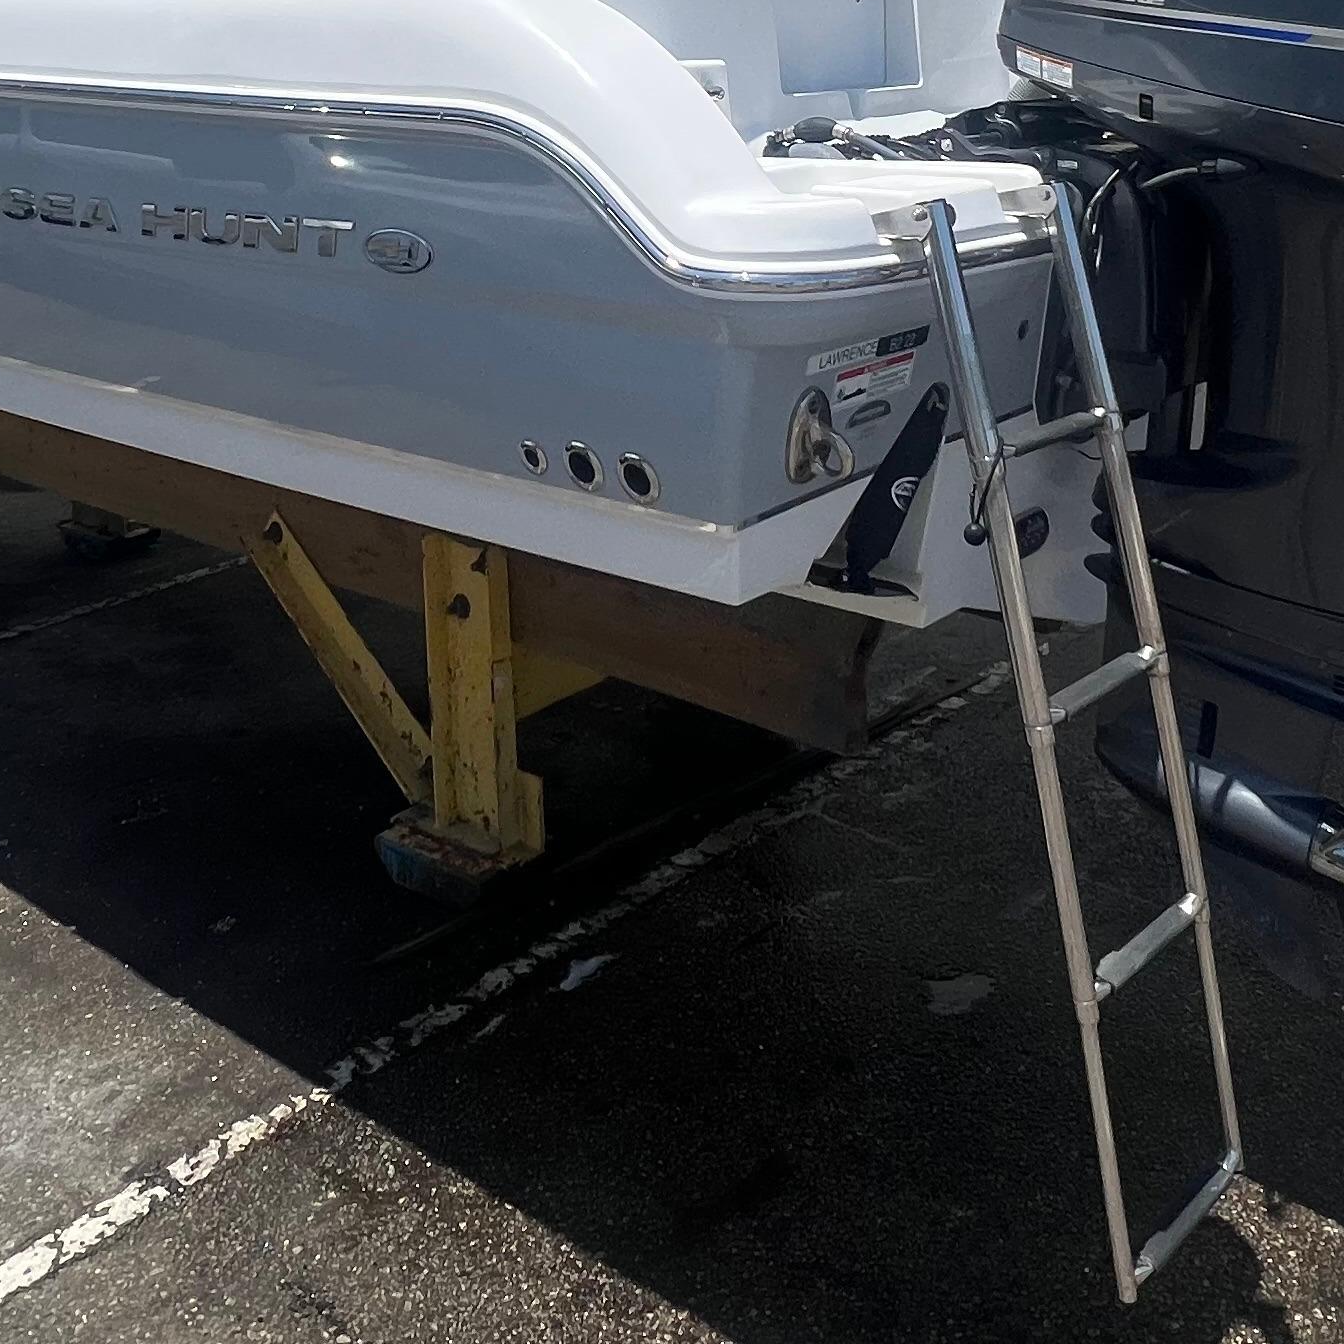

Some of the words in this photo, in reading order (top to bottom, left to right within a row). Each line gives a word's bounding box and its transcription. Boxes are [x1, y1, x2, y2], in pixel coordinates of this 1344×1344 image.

[2, 187, 120, 233] SEA
[141, 202, 354, 256] HUNT
[818, 341, 878, 369] LAWRENCE
